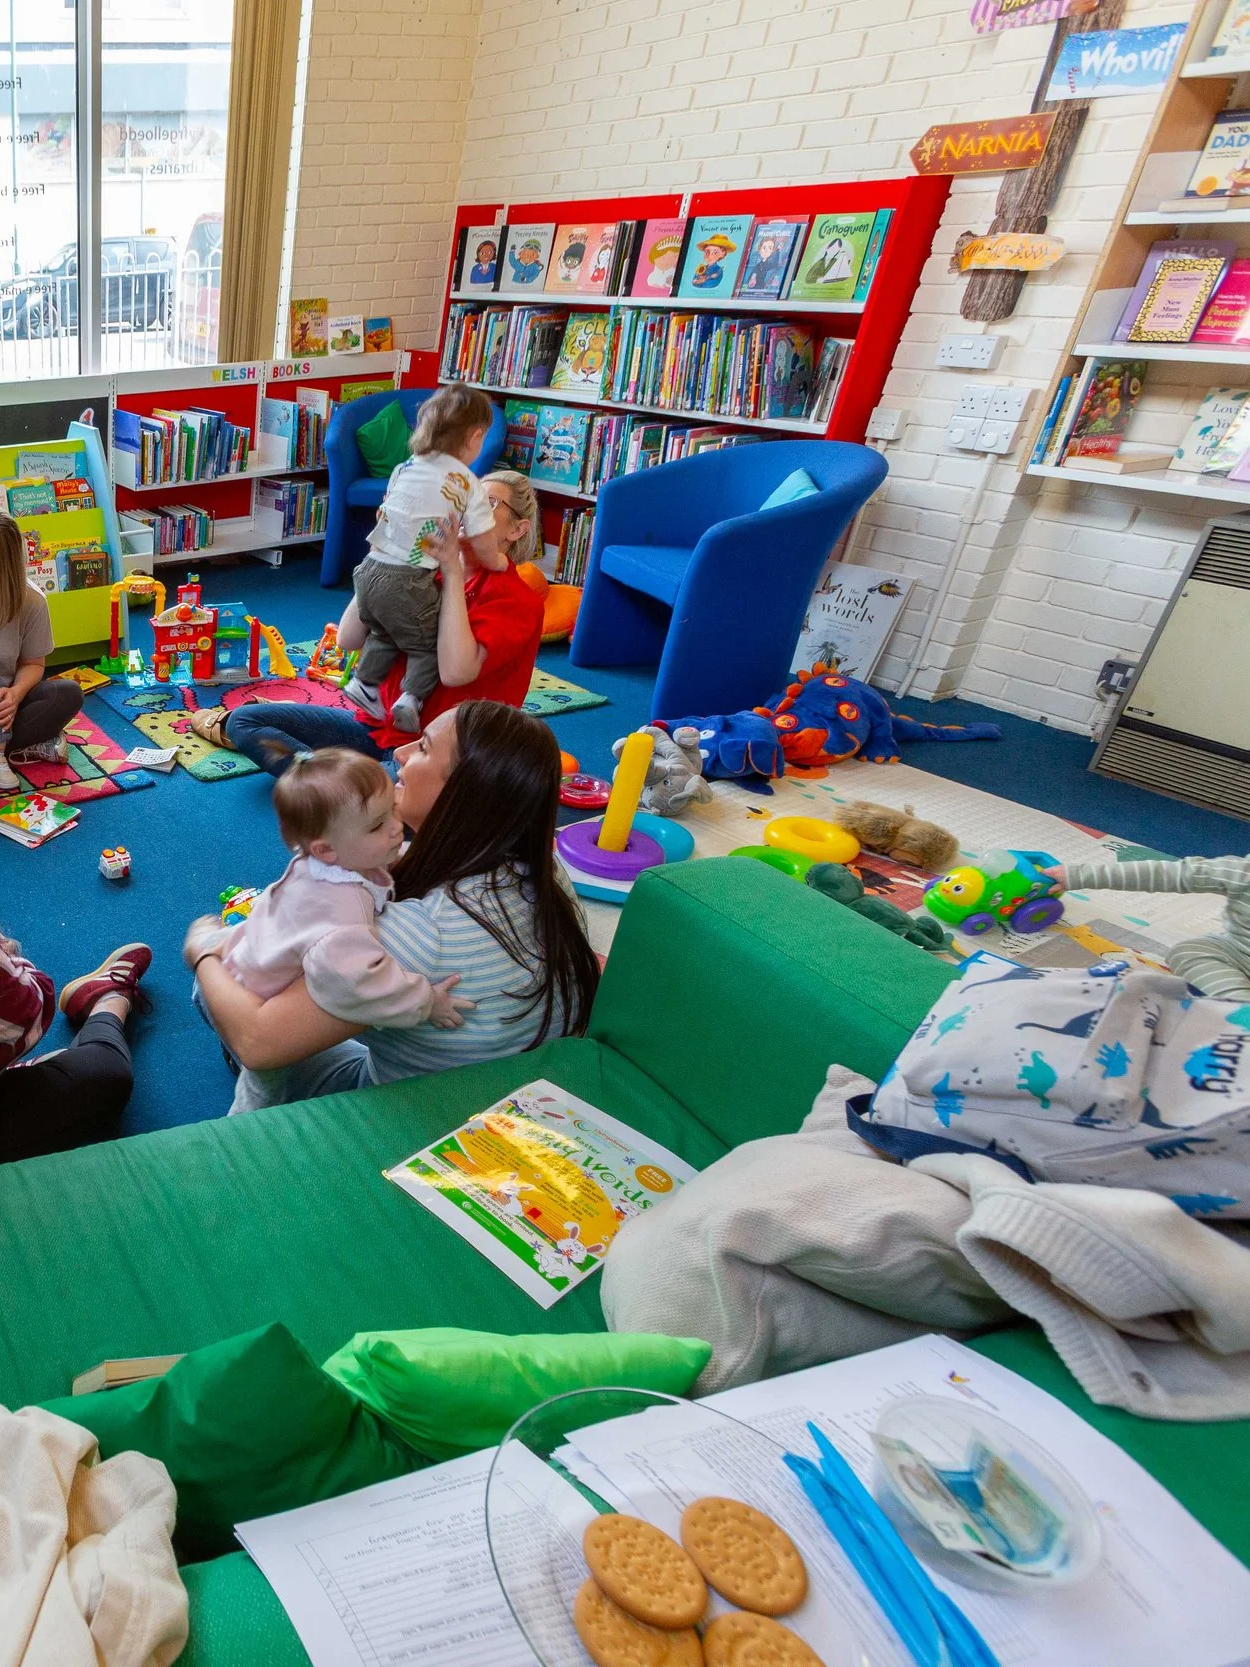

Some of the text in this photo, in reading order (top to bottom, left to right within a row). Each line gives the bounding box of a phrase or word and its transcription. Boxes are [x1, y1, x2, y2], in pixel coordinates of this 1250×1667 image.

[940, 131, 1042, 160] NARNIA
[700, 224, 719, 232] Vincent
[729, 225, 742, 233] Gogh
[1165, 247, 1219, 258] HELLO
[1152, 312, 1183, 320] Feelings
[211, 362, 311, 382] WELSH BOOKS
[1082, 439, 1114, 450] Healthy
[37, 566, 53, 575] Posy
[836, 588, 869, 610] lost
[822, 603, 875, 624] words
[1188, 1034, 1250, 1098] Harry
[574, 1135, 601, 1155] Easter
[581, 1155, 654, 1211] Words
[647, 1167, 669, 1185] FREE
